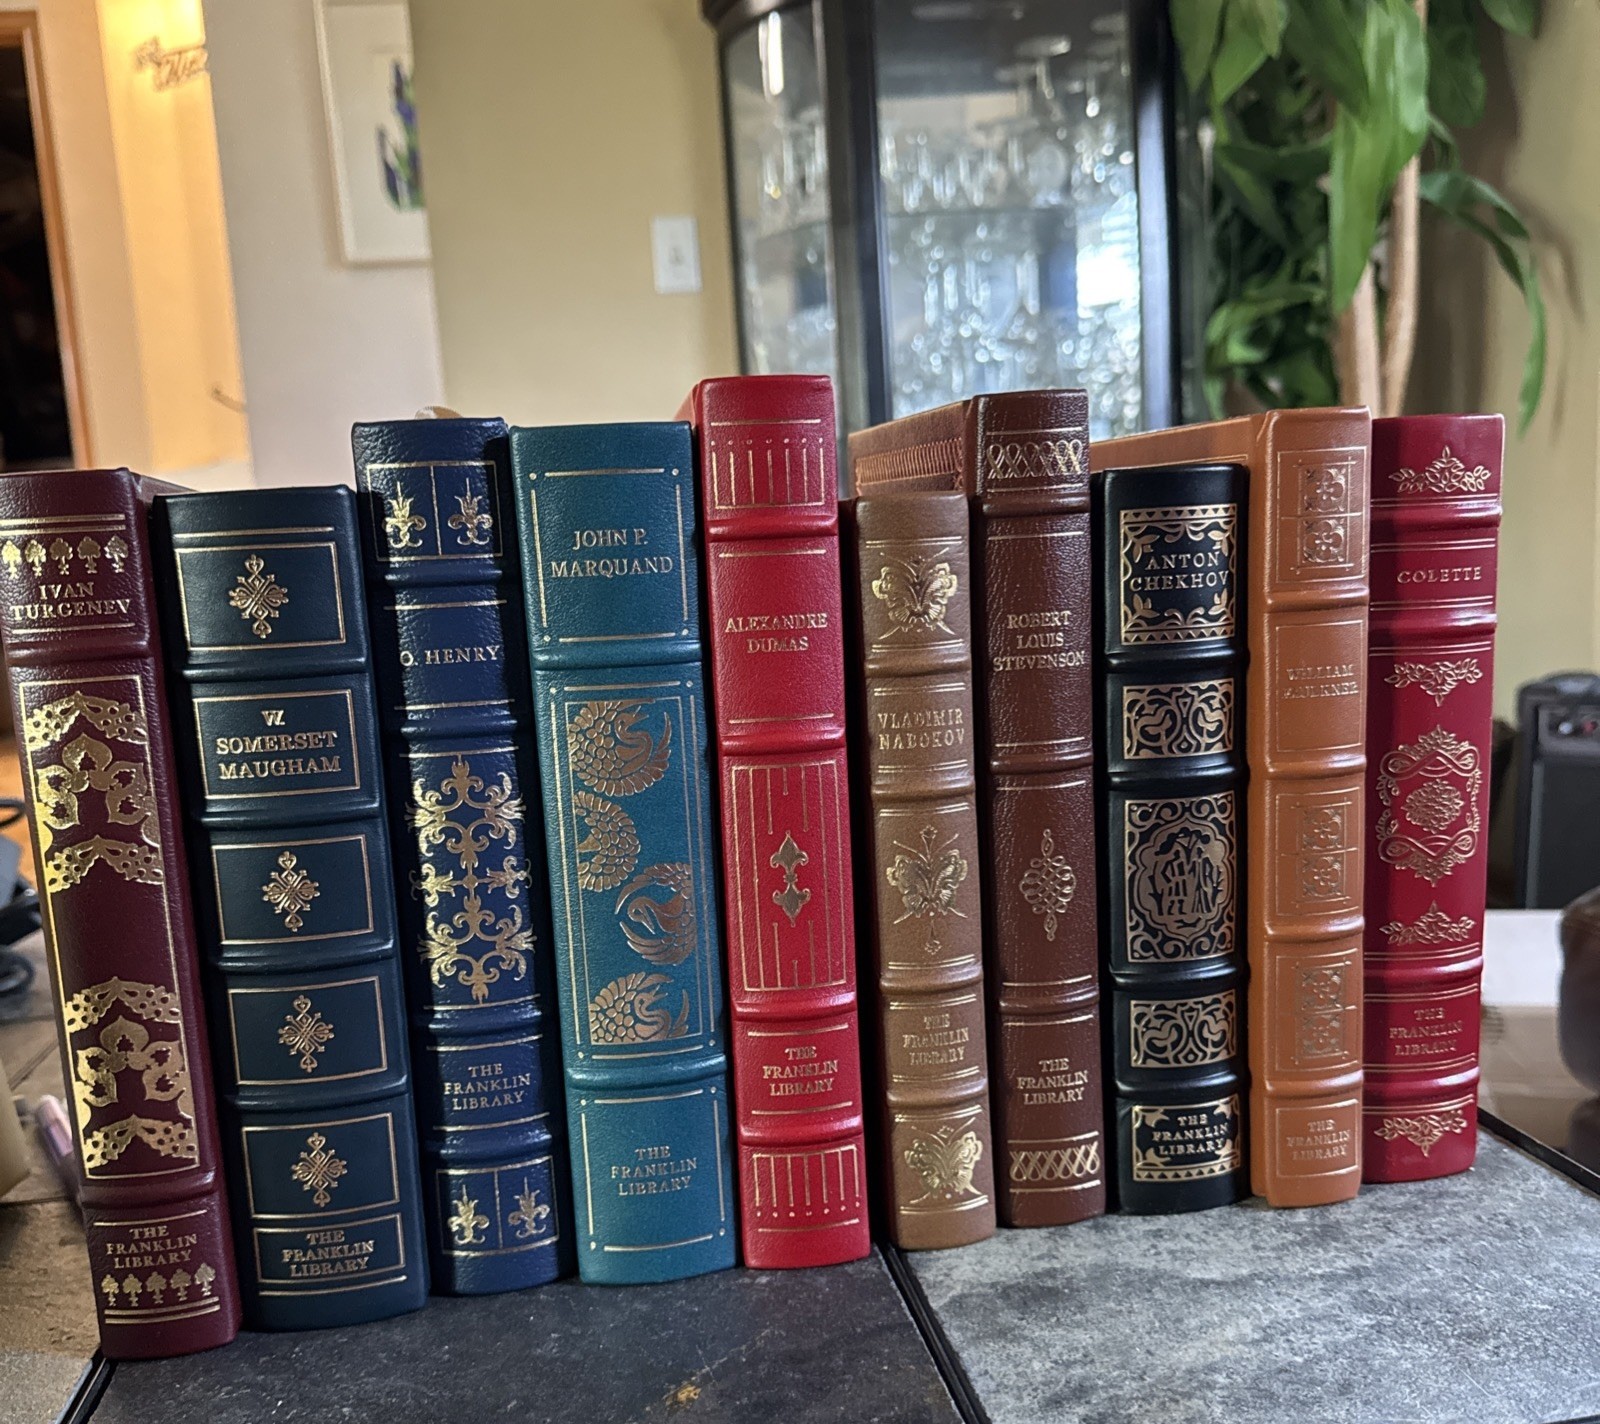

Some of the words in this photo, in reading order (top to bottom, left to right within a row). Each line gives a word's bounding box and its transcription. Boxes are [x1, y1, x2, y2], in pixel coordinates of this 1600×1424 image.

[572, 528, 628, 550] JOHN
[634, 528, 649, 546] P.
[551, 557, 674, 578] MARQUAND
[1144, 551, 1220, 571] ANTON
[1129, 571, 1229, 592] CHEKHOV
[1396, 566, 1482, 584] COLETTE
[39, 582, 95, 600] IVAN
[9, 599, 131, 621] TURGENEV
[724, 613, 828, 633] ALEXANDRE
[1007, 611, 1072, 630] ROBERT
[746, 636, 810, 654] DUMAS
[1016, 632, 1065, 650] LOUIS
[399, 650, 419, 667] O.
[424, 645, 500, 665] HENRY
[993, 650, 1086, 672] STEVENSON
[1286, 664, 1354, 681] WILLIAM
[260, 709, 286, 727] W.
[877, 708, 963, 729] VLADIMIR
[216, 731, 339, 756] SOMERSET
[879, 728, 966, 750] NABOKOV
[218, 755, 341, 780] MAUGHAM
[923, 1014, 951, 1030] THE
[902, 1027, 970, 1048] FRANKLIN
[784, 1046, 818, 1061] THE
[909, 1046, 966, 1066] LIBRARY
[467, 1063, 504, 1078] THE
[762, 1059, 839, 1079] FRANKLIN
[1039, 1058, 1070, 1073] THE
[443, 1073, 531, 1095] FRANKLIN
[769, 1078, 835, 1097] LIBRARY
[1016, 1070, 1089, 1090] FRANKLIN
[452, 1090, 525, 1111] LIBRARY
[1023, 1087, 1085, 1106] LIBRARY
[1177, 1113, 1208, 1127] THE
[1307, 1119, 1336, 1133] THE
[1152, 1122, 1229, 1142] FRANKLIN
[1286, 1129, 1352, 1148] FRANKLIN
[634, 1145, 671, 1161] THE
[1159, 1138, 1224, 1156] LIBRARY
[1292, 1143, 1348, 1161] LIBRARY
[610, 1157, 697, 1179] FRANKLIN
[618, 1175, 692, 1197] LIBRARY
[129, 1225, 170, 1240] THE
[305, 1229, 346, 1246] THE
[105, 1233, 198, 1256] FRANKLIN
[281, 1240, 375, 1263] FRANKLIN
[113, 1249, 192, 1269] LIBRARY
[290, 1256, 370, 1278] LIBRARY
